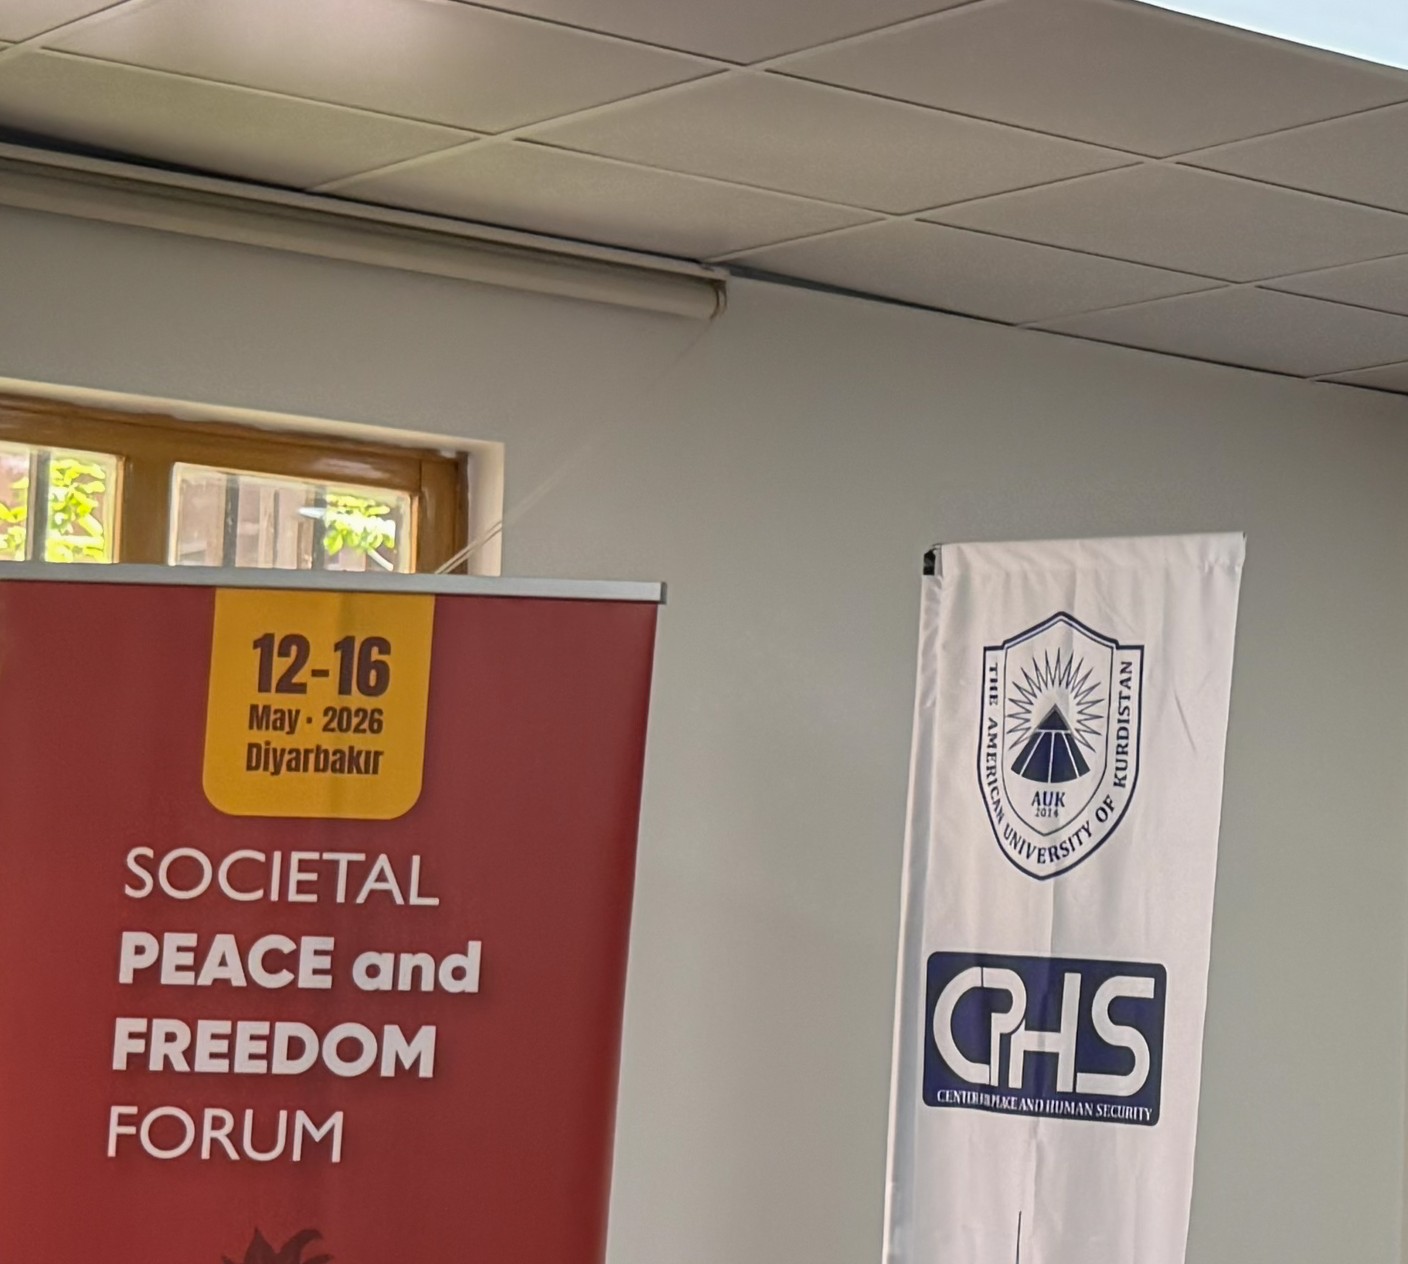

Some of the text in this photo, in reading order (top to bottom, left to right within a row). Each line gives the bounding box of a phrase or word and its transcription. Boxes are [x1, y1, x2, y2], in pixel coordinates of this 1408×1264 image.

[252, 632, 391, 697] 12-16
[248, 705, 384, 737] May 2026
[245, 742, 383, 776] Diyarbakır
[986, 661, 1132, 864] THE AMERICAN UNIVERSITY OF KURDISTAN
[1031, 791, 1066, 808] AUK
[124, 846, 440, 905] SOCIETAL
[118, 931, 482, 993] PEACE and
[111, 1017, 437, 1078] FREEDOM
[933, 966, 1155, 1097] CPHS
[106, 1105, 344, 1163] FORUM
[1095, 1104, 1153, 1121] SECURITY
